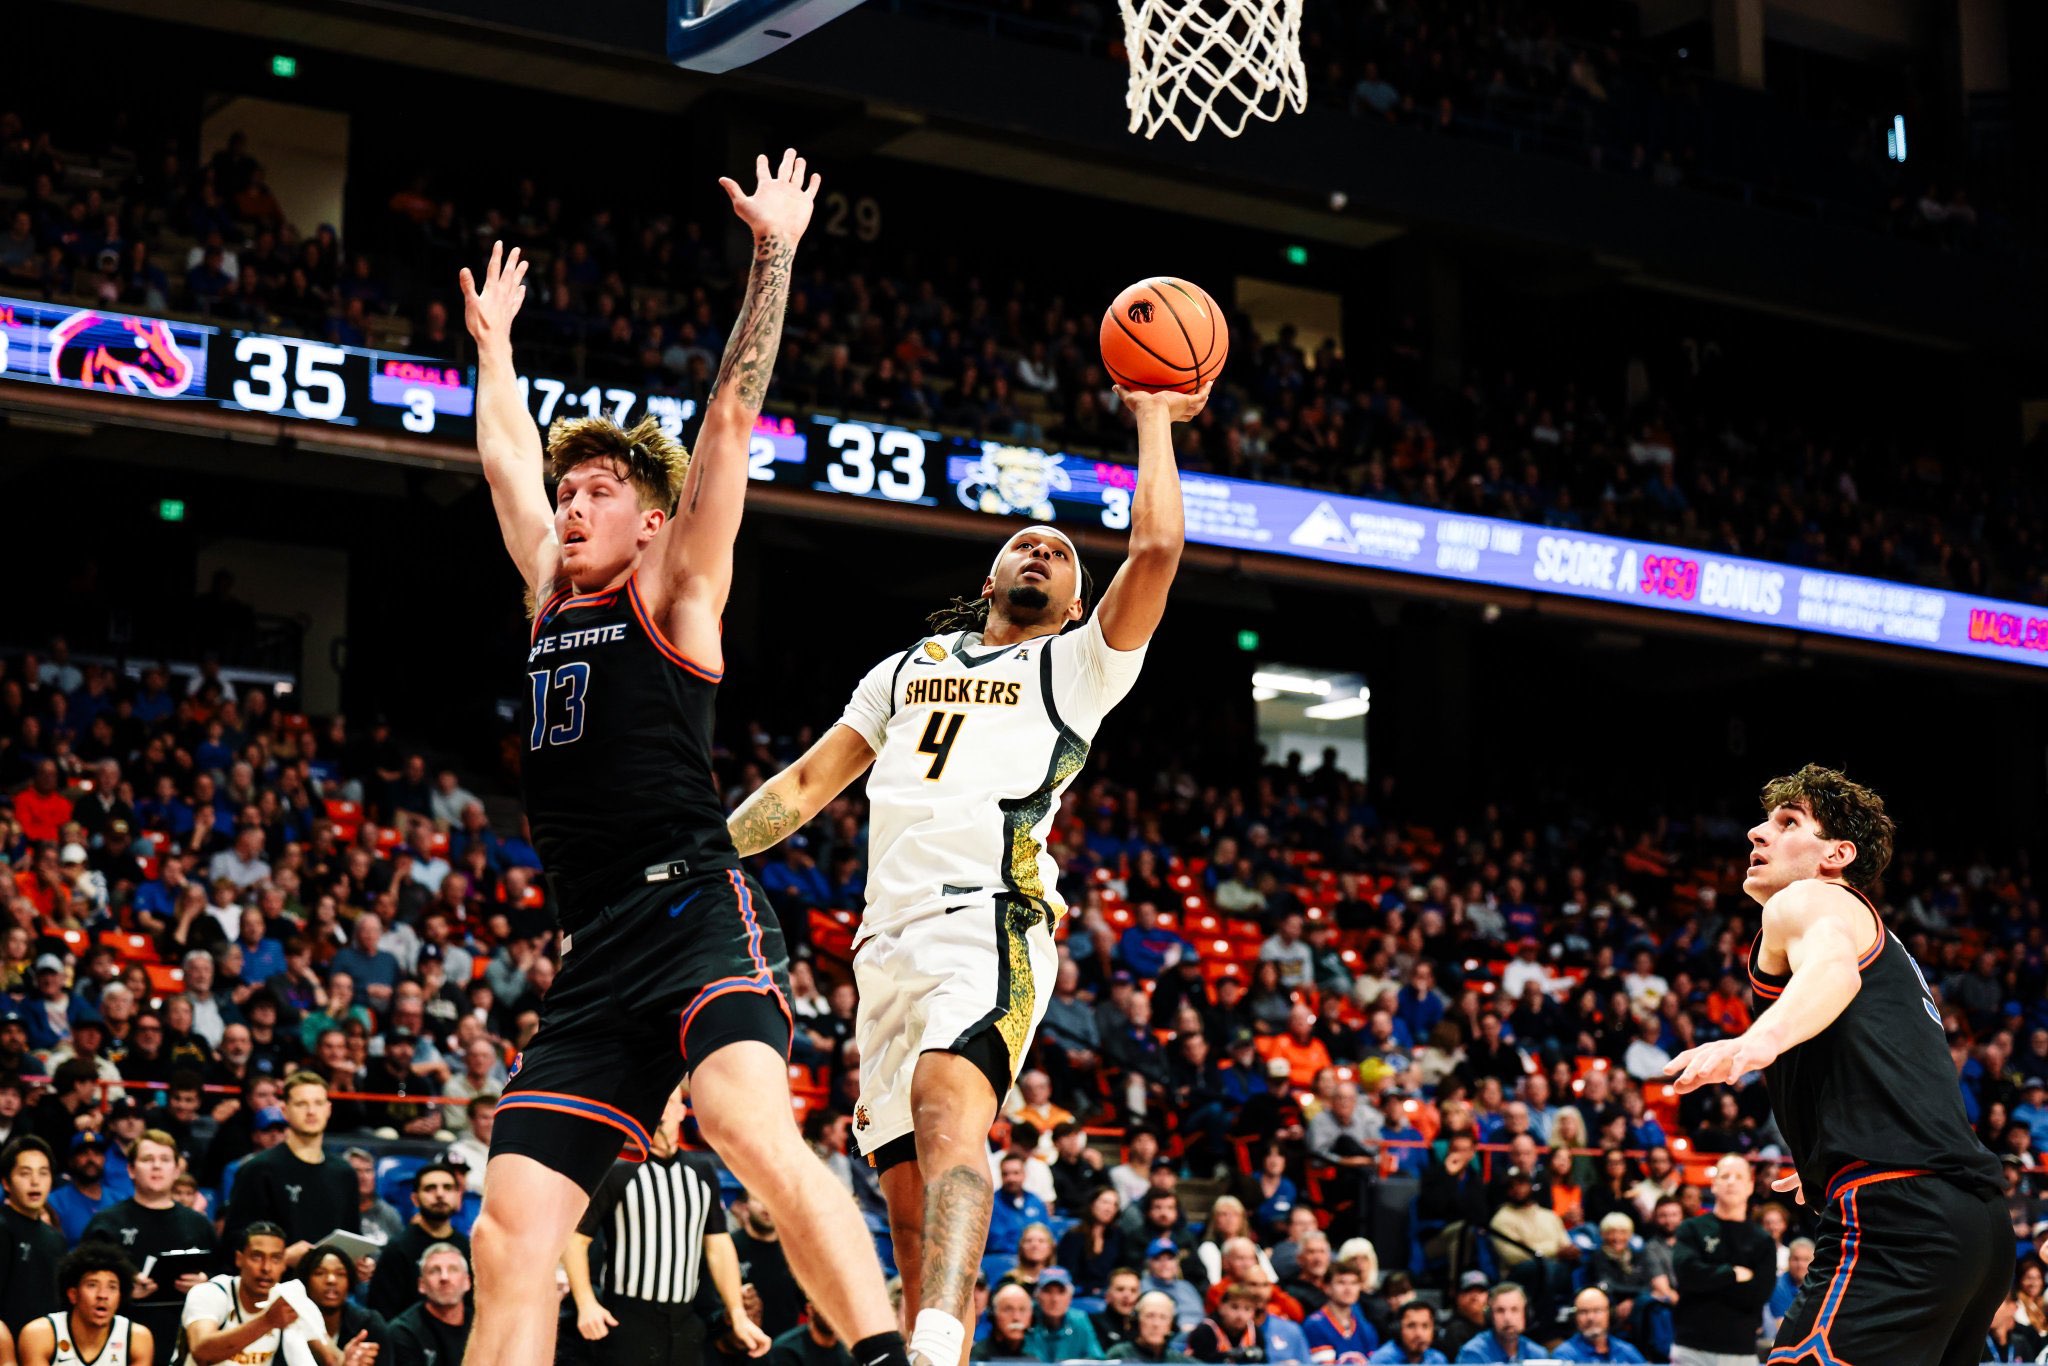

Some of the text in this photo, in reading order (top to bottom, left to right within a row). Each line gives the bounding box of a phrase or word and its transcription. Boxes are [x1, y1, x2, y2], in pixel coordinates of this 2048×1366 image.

[825, 192, 880, 241] 29
[233, 336, 346, 421] 35
[384, 360, 461, 389] FOULS
[402, 388, 435, 433] 3
[749, 436, 775, 481] 2
[826, 422, 926, 501] 33
[1101, 487, 1130, 529] 3
[1533, 536, 1618, 589] SCORE
[1616, 548, 1638, 593] A
[1700, 561, 1785, 615] BONUS
[560, 623, 627, 650] STATE
[528, 661, 590, 751] 13
[905, 677, 1022, 707] SHOCKERS
[916, 709, 968, 783] 4
